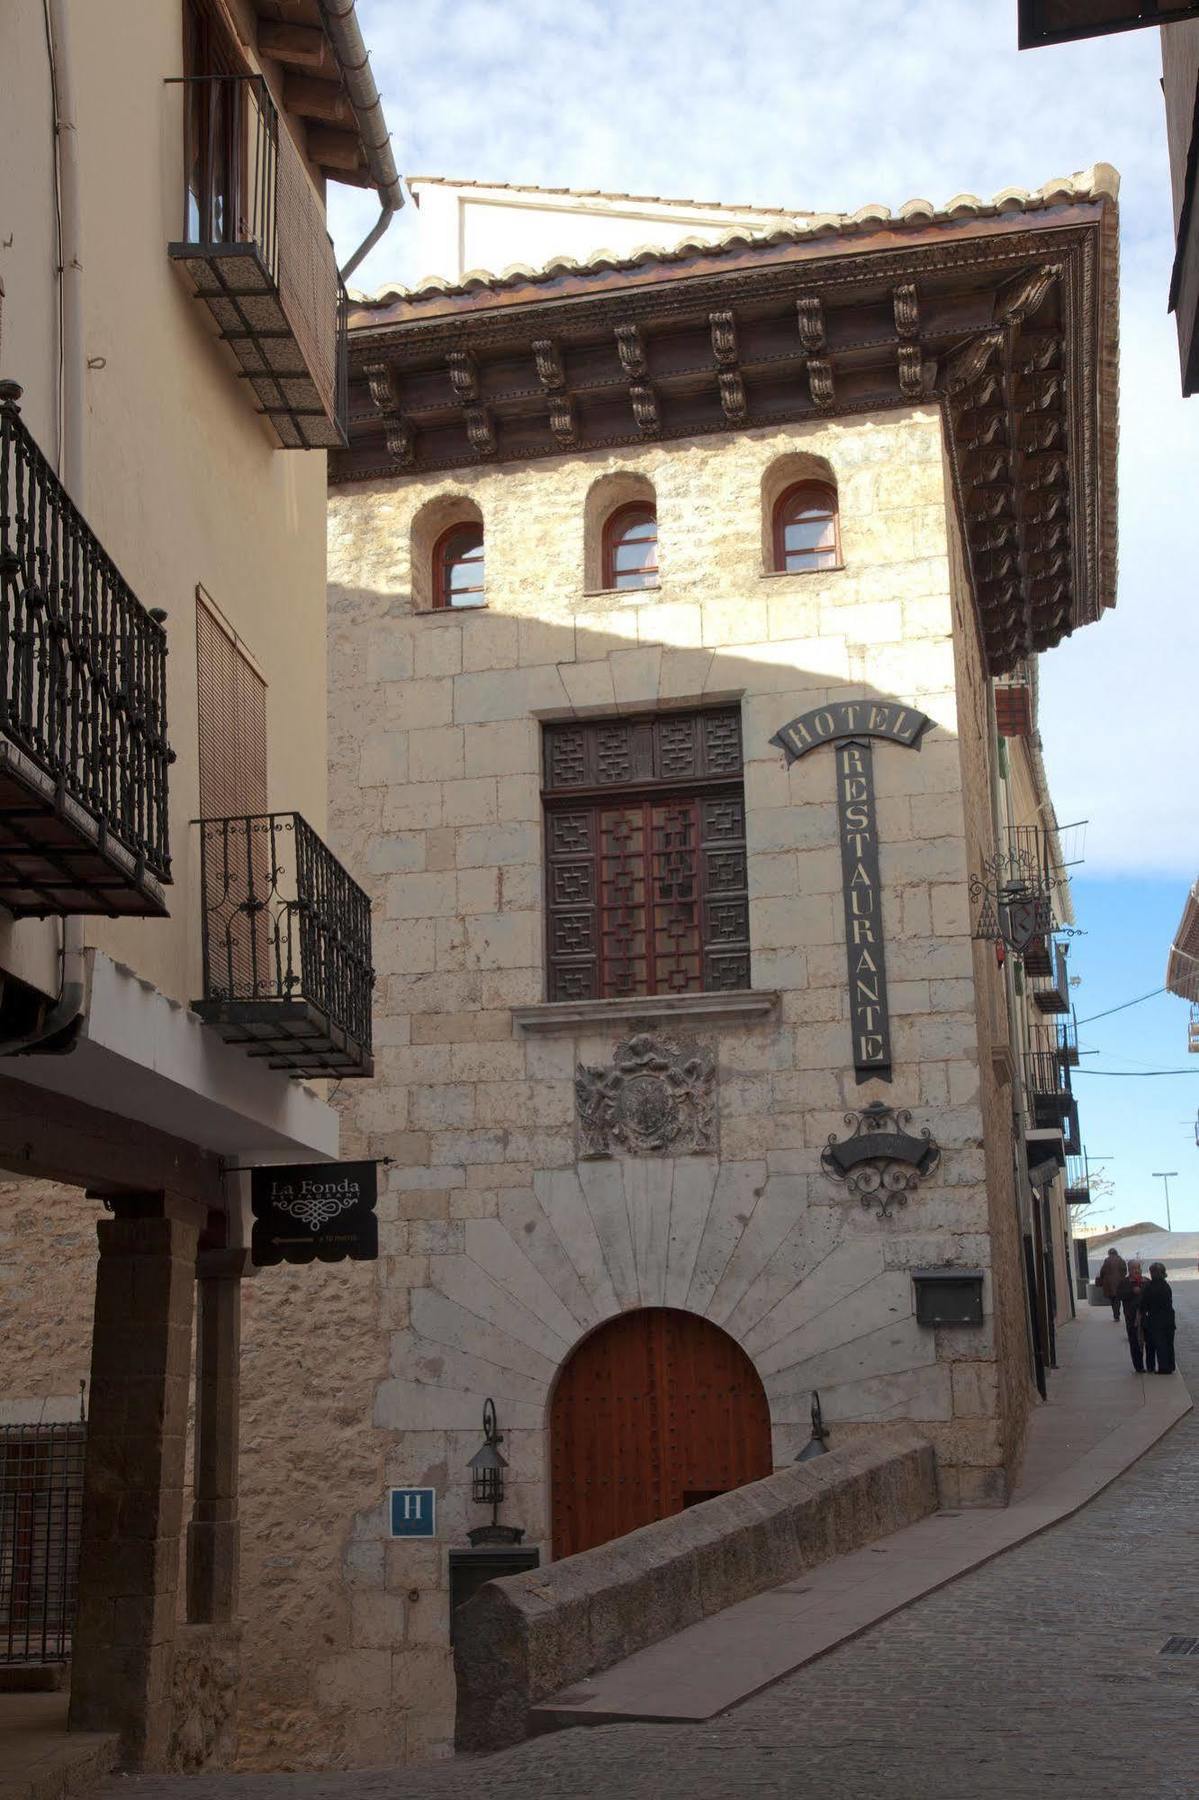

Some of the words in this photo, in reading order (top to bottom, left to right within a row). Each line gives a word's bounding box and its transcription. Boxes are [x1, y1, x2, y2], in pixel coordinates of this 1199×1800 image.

[788, 705, 912, 748] HOTEL
[842, 750, 884, 1061] RESTAURANTE
[271, 1182, 293, 1195] La
[301, 1178, 360, 1194] Fonda
[402, 1494, 422, 1519] H
